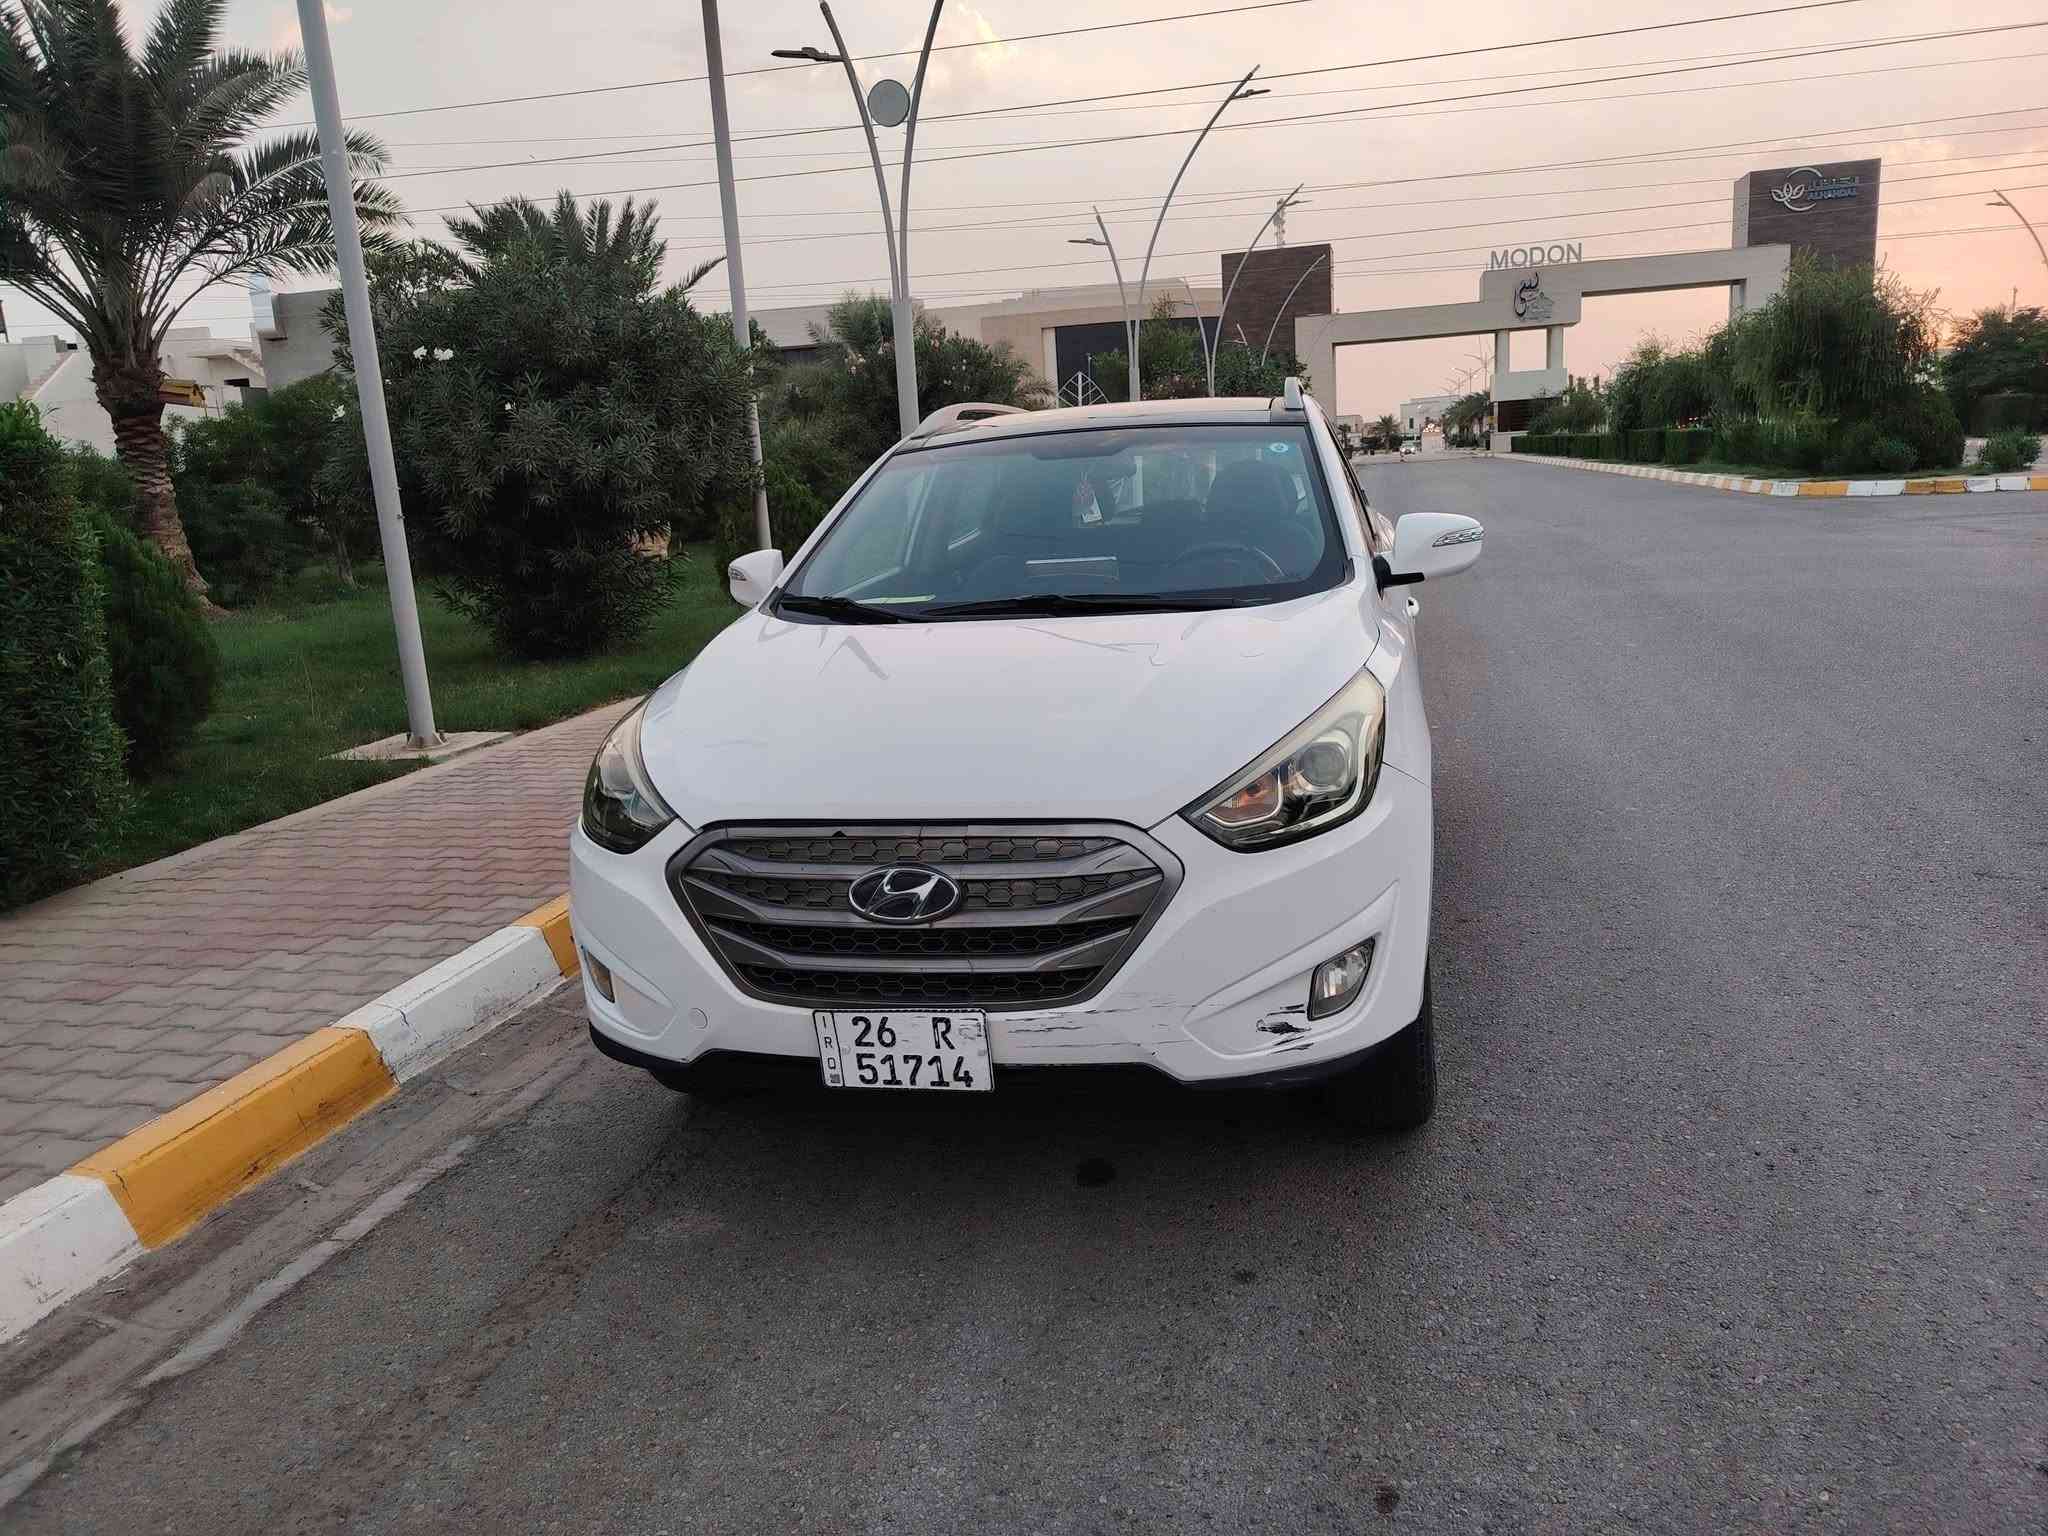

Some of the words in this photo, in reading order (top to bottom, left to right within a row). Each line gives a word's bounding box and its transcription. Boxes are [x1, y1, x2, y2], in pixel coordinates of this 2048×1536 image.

[1490, 242, 1582, 270] MODON
[851, 1015, 897, 1049] 26
[931, 1016, 956, 1050] R
[855, 1052, 974, 1088] 51714
